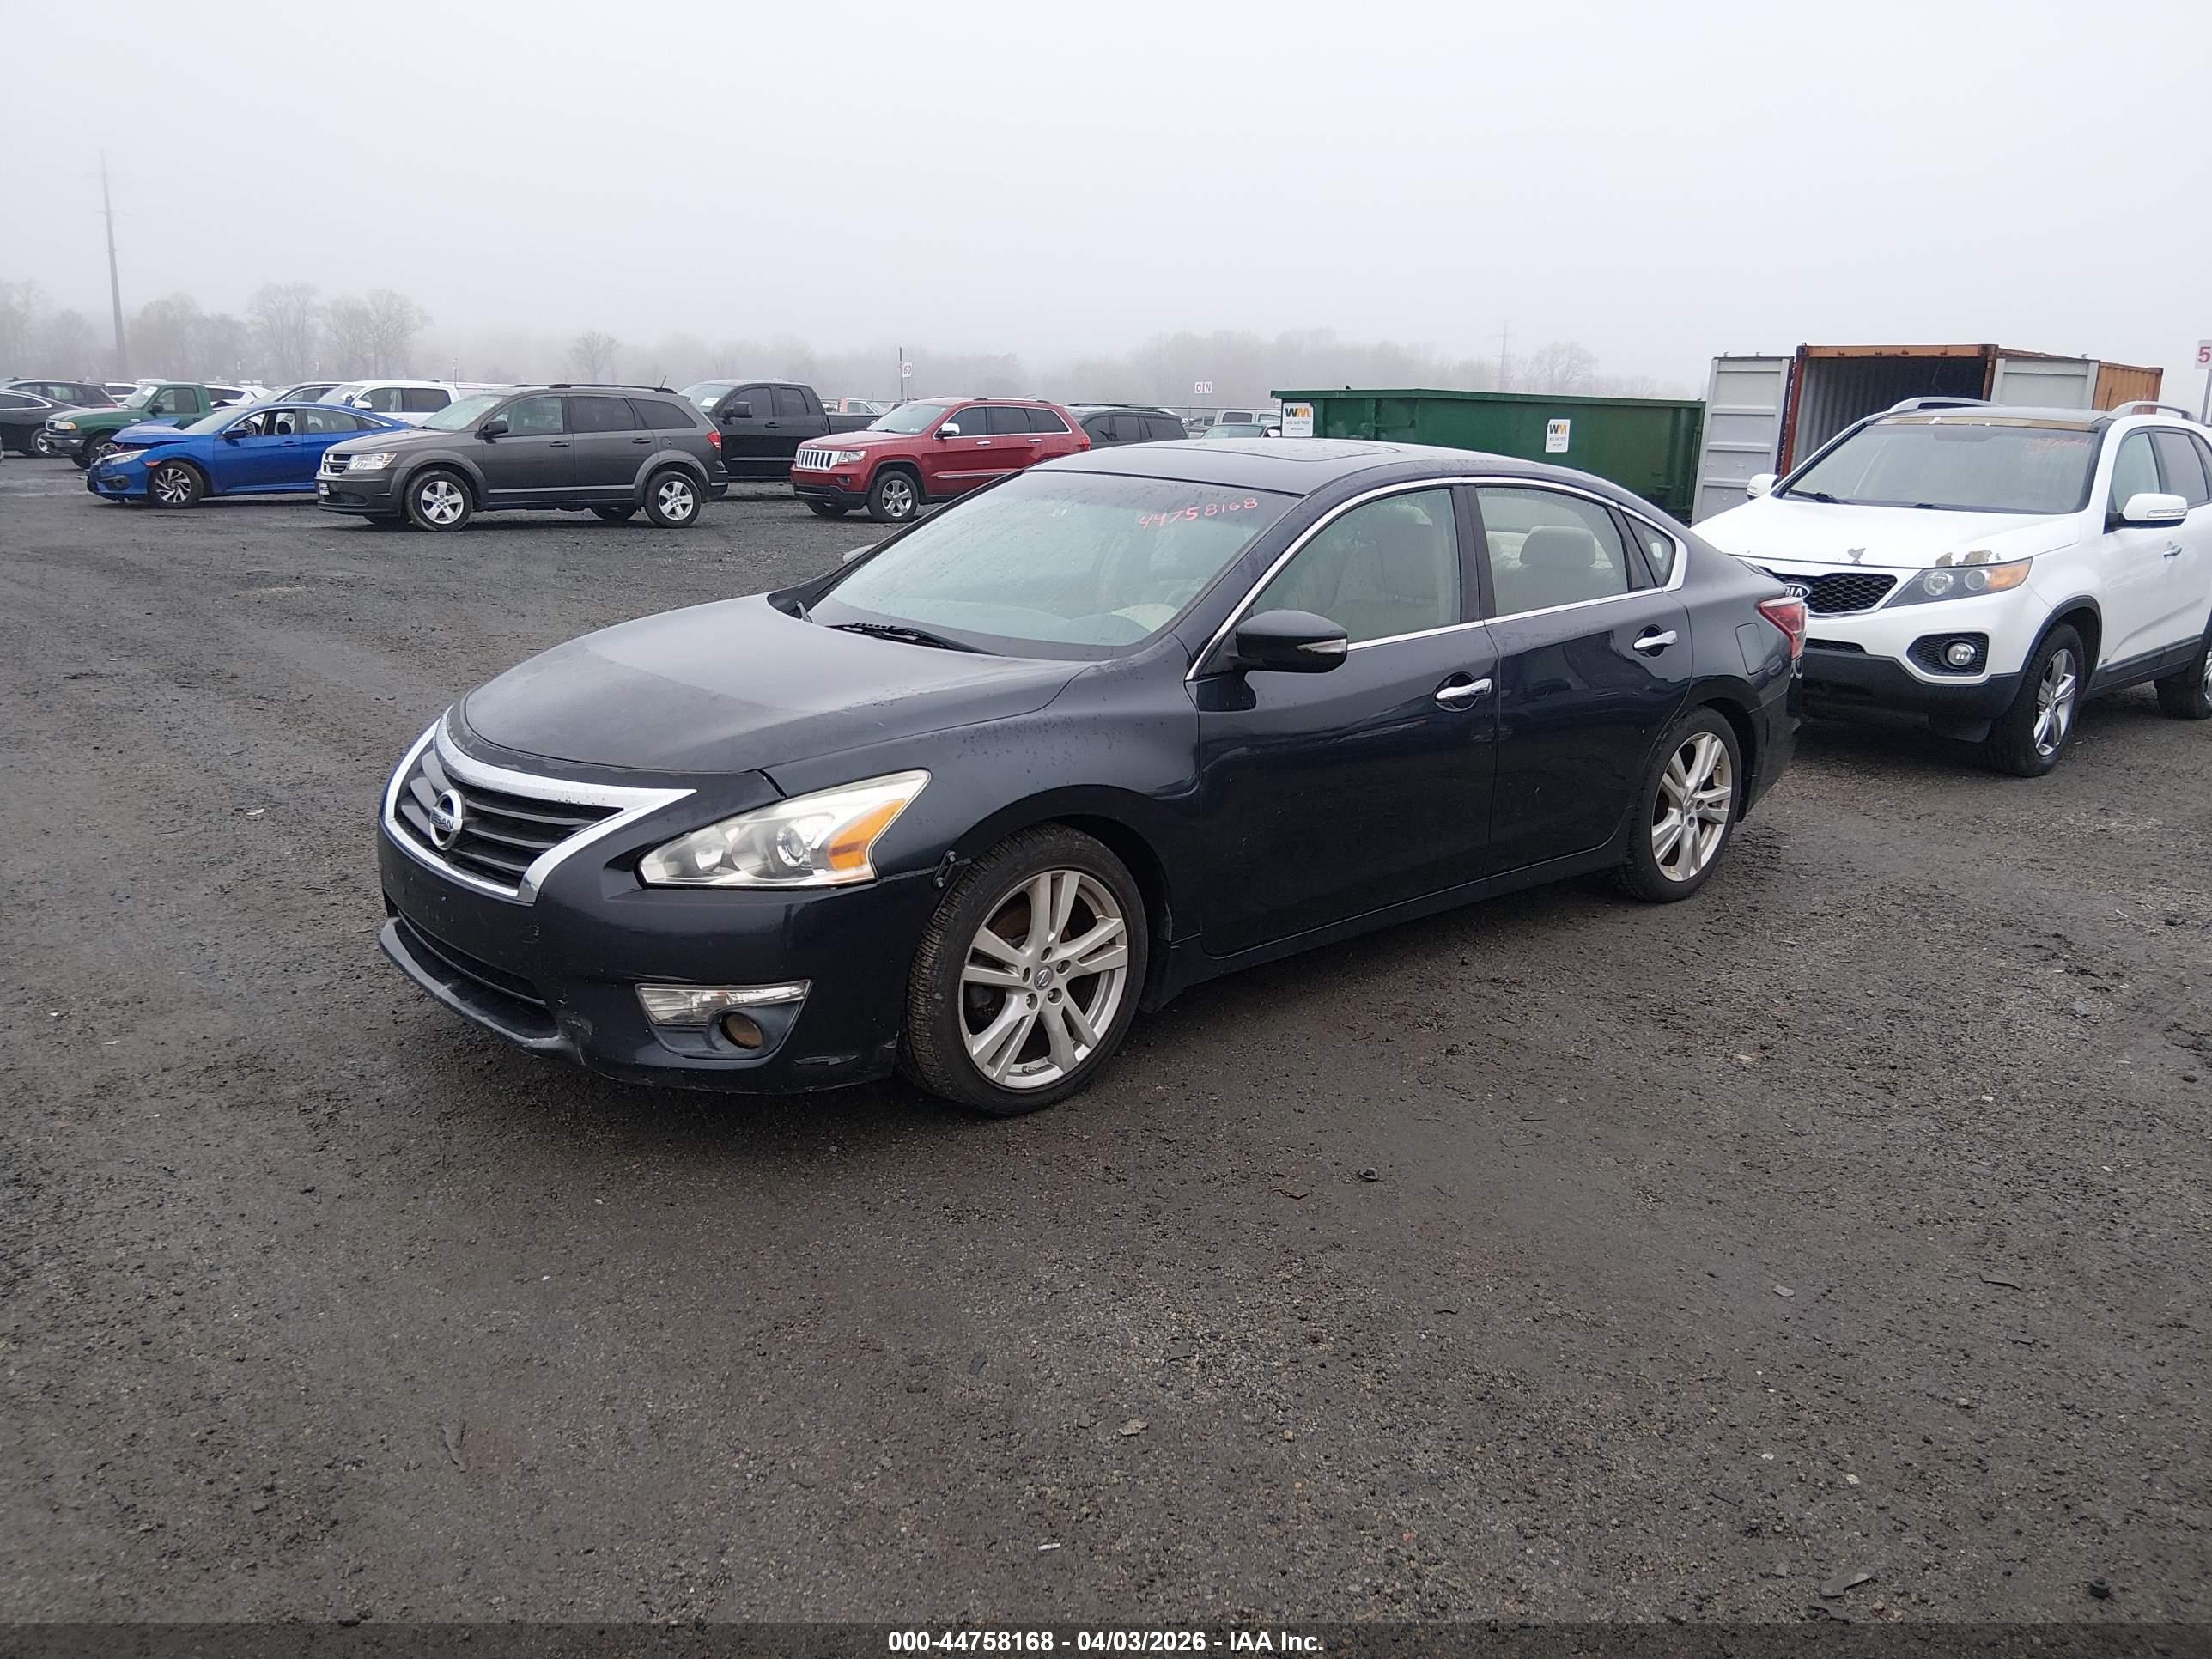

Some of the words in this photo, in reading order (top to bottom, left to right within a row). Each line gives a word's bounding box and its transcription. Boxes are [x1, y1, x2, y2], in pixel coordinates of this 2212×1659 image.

[1285, 408, 1310, 417] WM
[1549, 424, 1567, 434] WM
[1139, 497, 1258, 529] 44758168
[431, 811, 454, 830] SSAN
